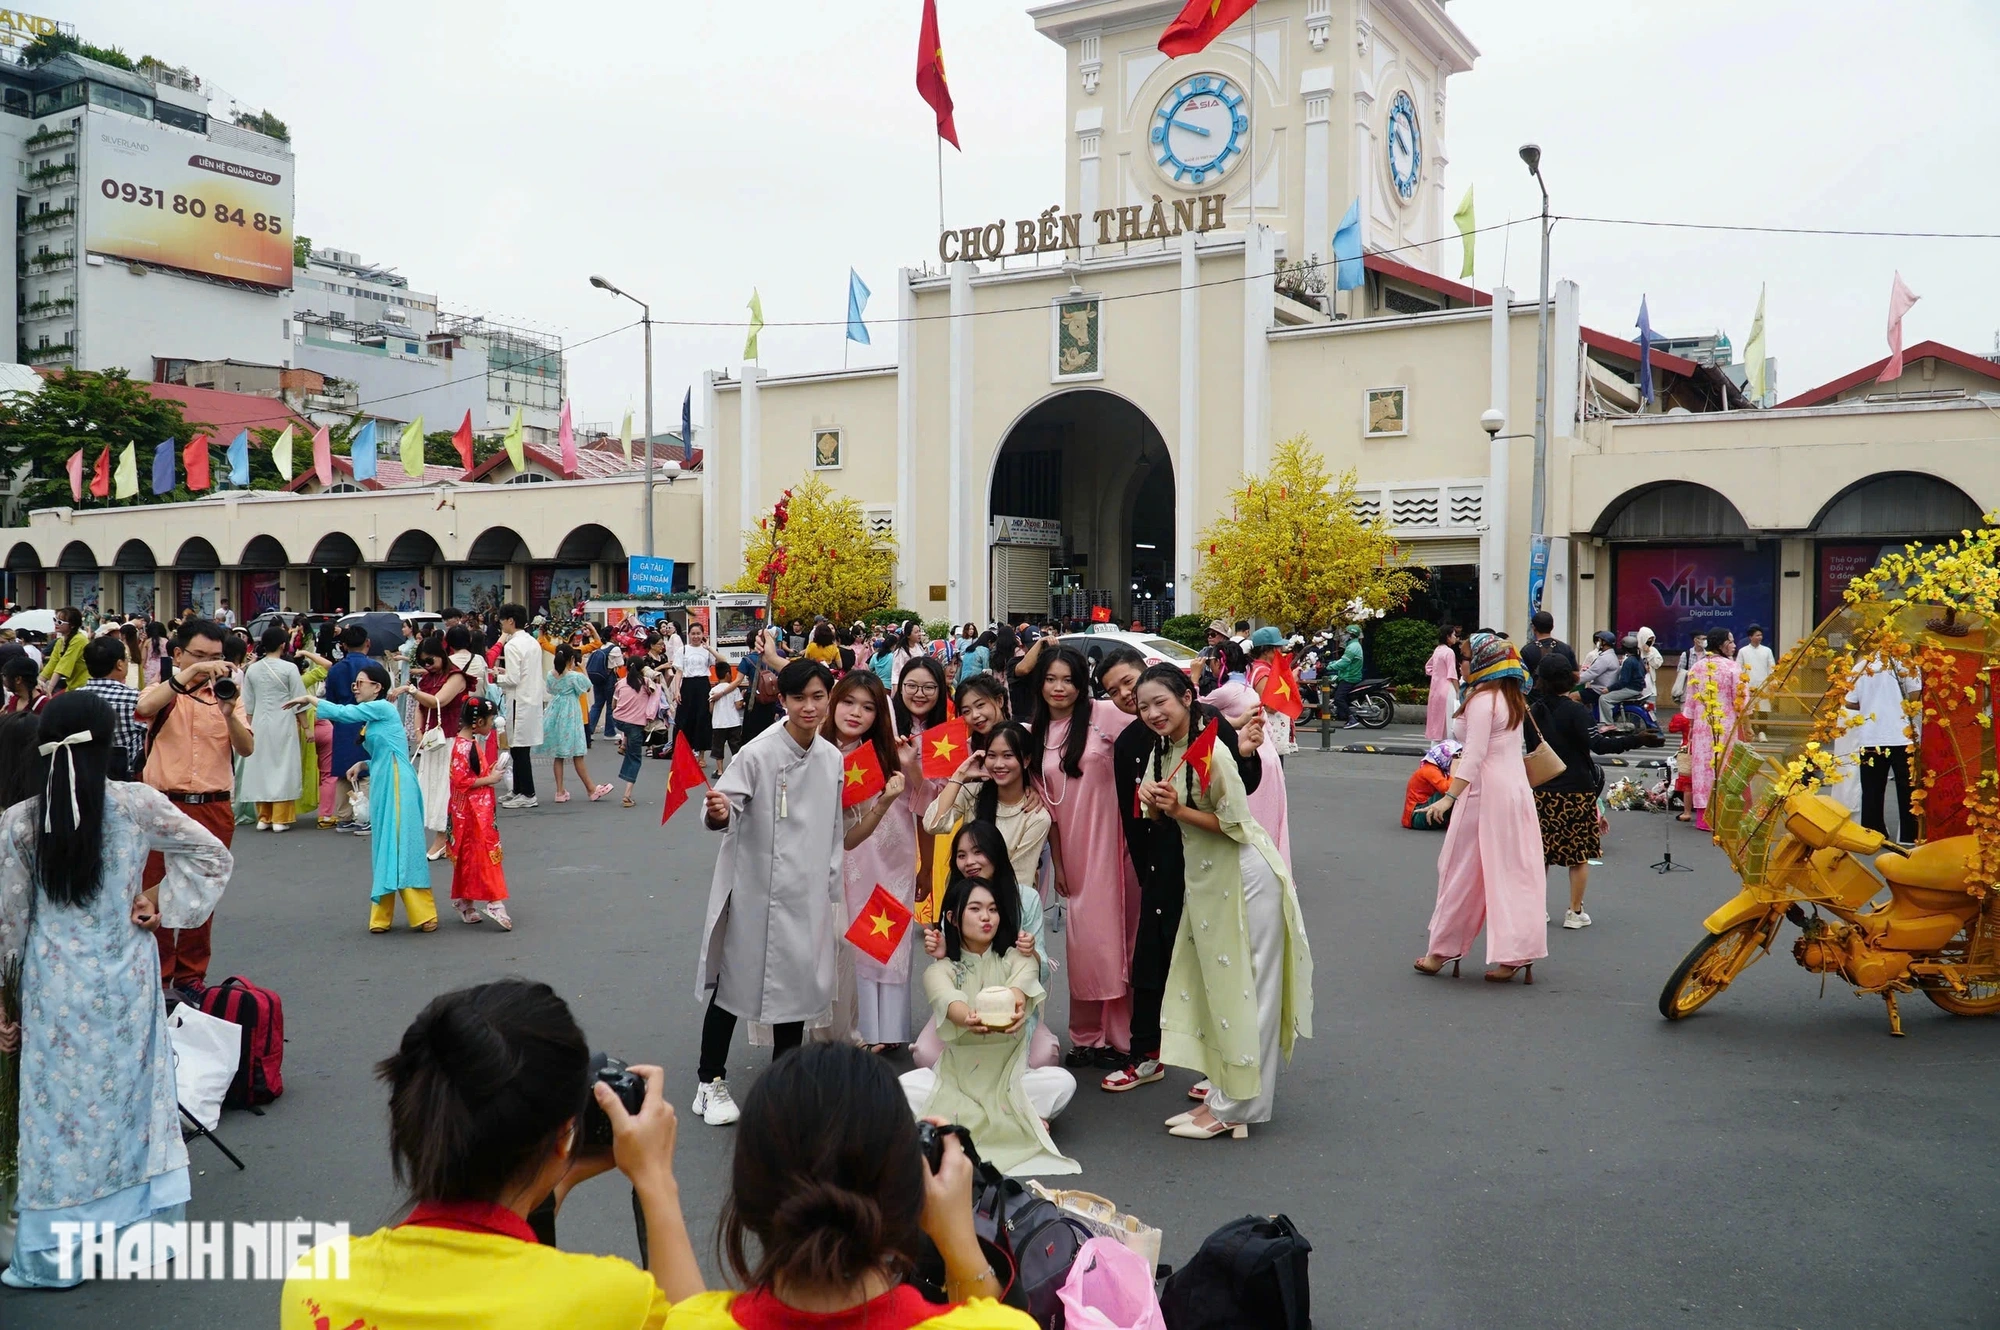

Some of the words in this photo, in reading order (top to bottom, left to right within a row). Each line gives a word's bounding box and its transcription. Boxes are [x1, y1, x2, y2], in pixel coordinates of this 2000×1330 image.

[1189, 75, 1211, 93] 12
[1234, 115, 1248, 134] 3
[101, 134, 150, 152] SILVERLAND
[1151, 126, 1164, 143] 9
[199, 158, 215, 169] LIÊN
[216, 162, 226, 172] HỆ
[227, 163, 255, 178] QUẢNG
[256, 172, 273, 183] CÁO
[101, 178, 164, 210] 0931
[172, 194, 206, 218] 80
[214, 203, 246, 227] 84
[253, 212, 282, 235] 85
[939, 218, 1006, 263] CHỢ
[1015, 205, 1082, 254] BẾN
[1093, 194, 1227, 244] THÀNH
[640, 562, 649, 570] GA
[651, 562, 664, 572] TÀU
[637, 585, 659, 593] METRO
[1651, 564, 1734, 607] Vikki
[1689, 610, 1714, 618] Digital
